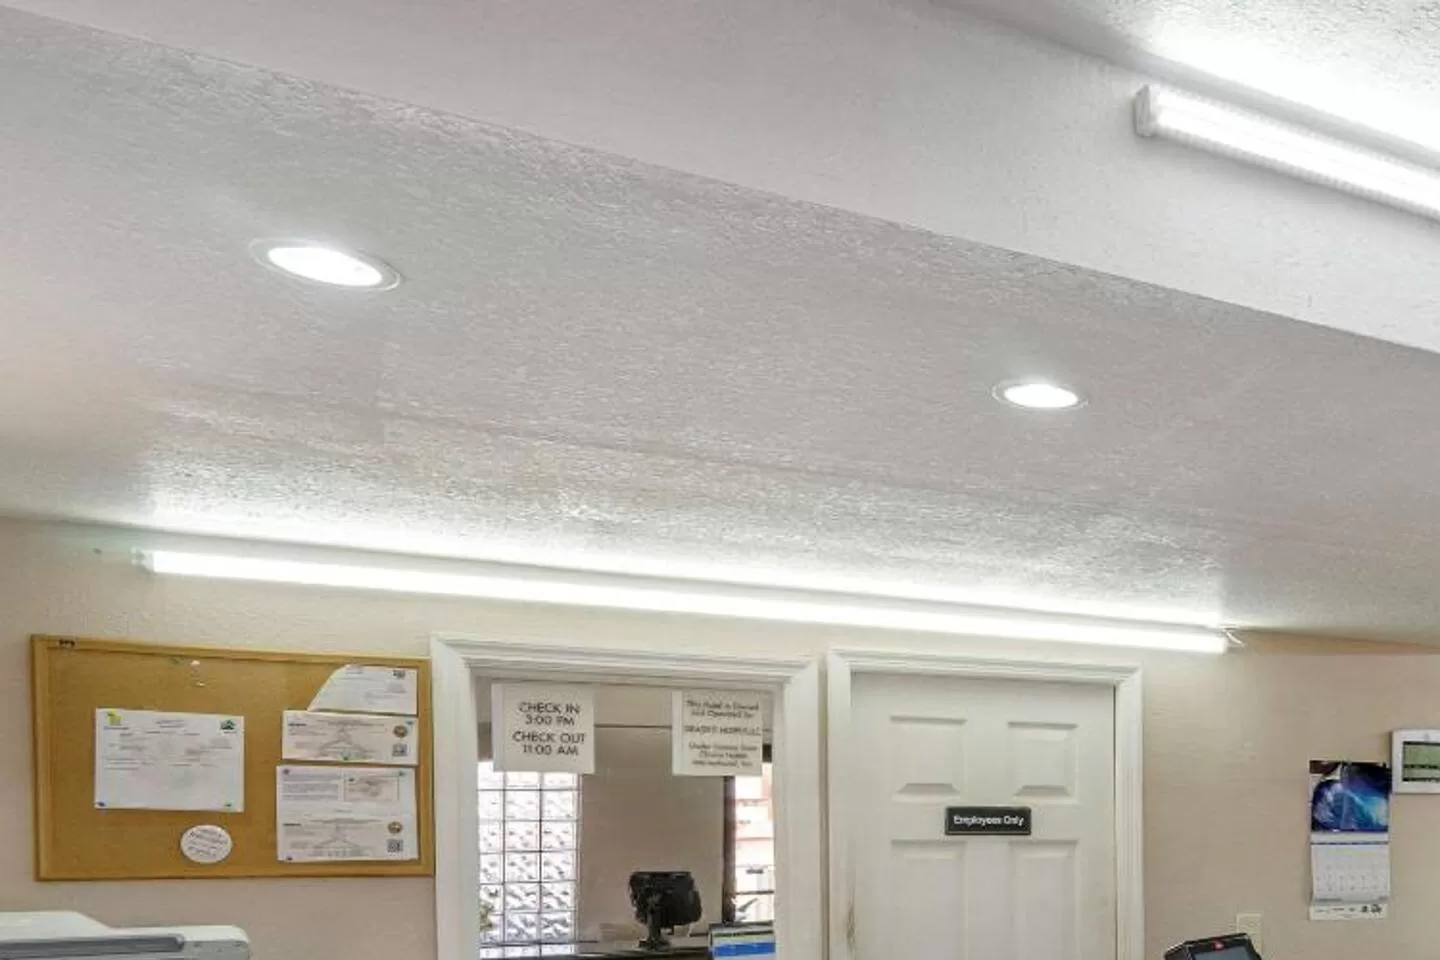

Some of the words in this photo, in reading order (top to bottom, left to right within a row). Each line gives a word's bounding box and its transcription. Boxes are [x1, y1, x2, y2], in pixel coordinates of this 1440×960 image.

[518, 702, 562, 713] CHECK
[565, 703, 581, 714] IN
[556, 715, 575, 726] PM
[512, 731, 557, 742] CHECK
[560, 732, 585, 744] OUT
[556, 745, 579, 756] AM
[953, 815, 1002, 827] Employees
[1003, 815, 1025, 827] Only
